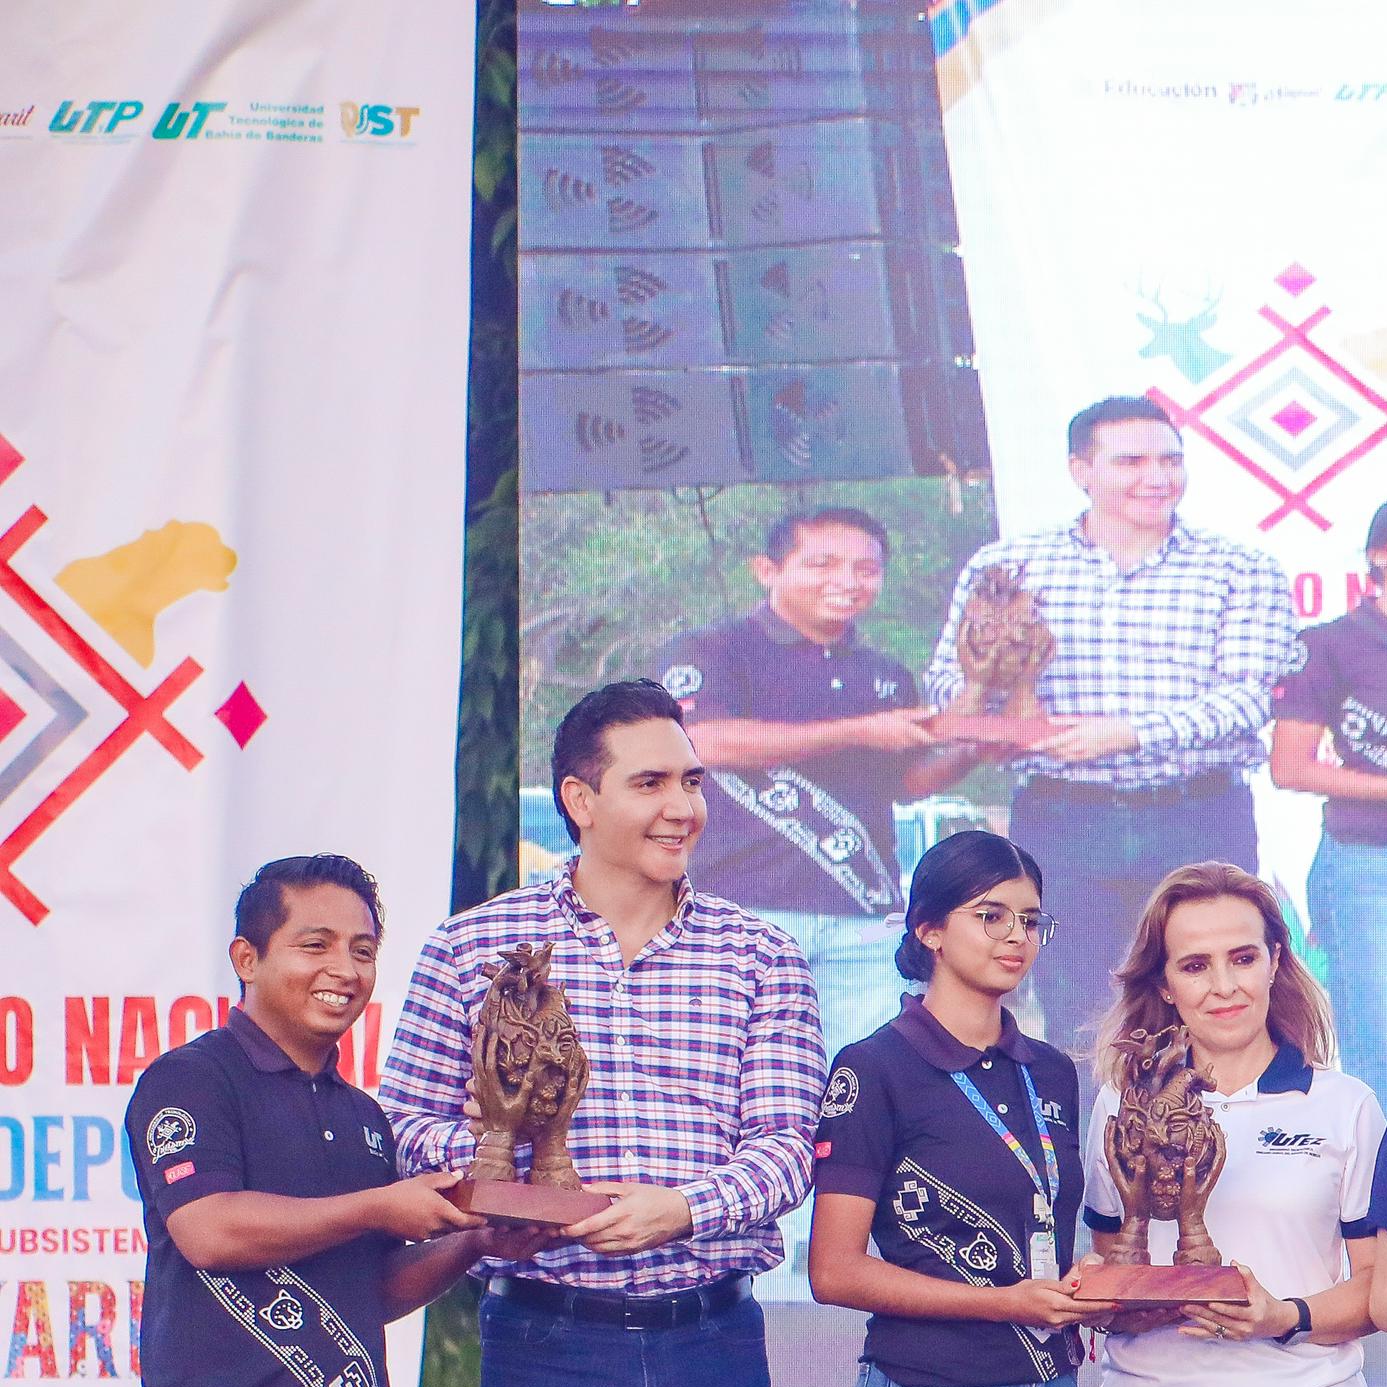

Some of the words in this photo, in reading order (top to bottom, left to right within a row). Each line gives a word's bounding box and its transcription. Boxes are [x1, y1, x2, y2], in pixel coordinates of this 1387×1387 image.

[49, 100, 144, 133] UTP
[152, 102, 228, 139] UT
[308, 117, 324, 128] de
